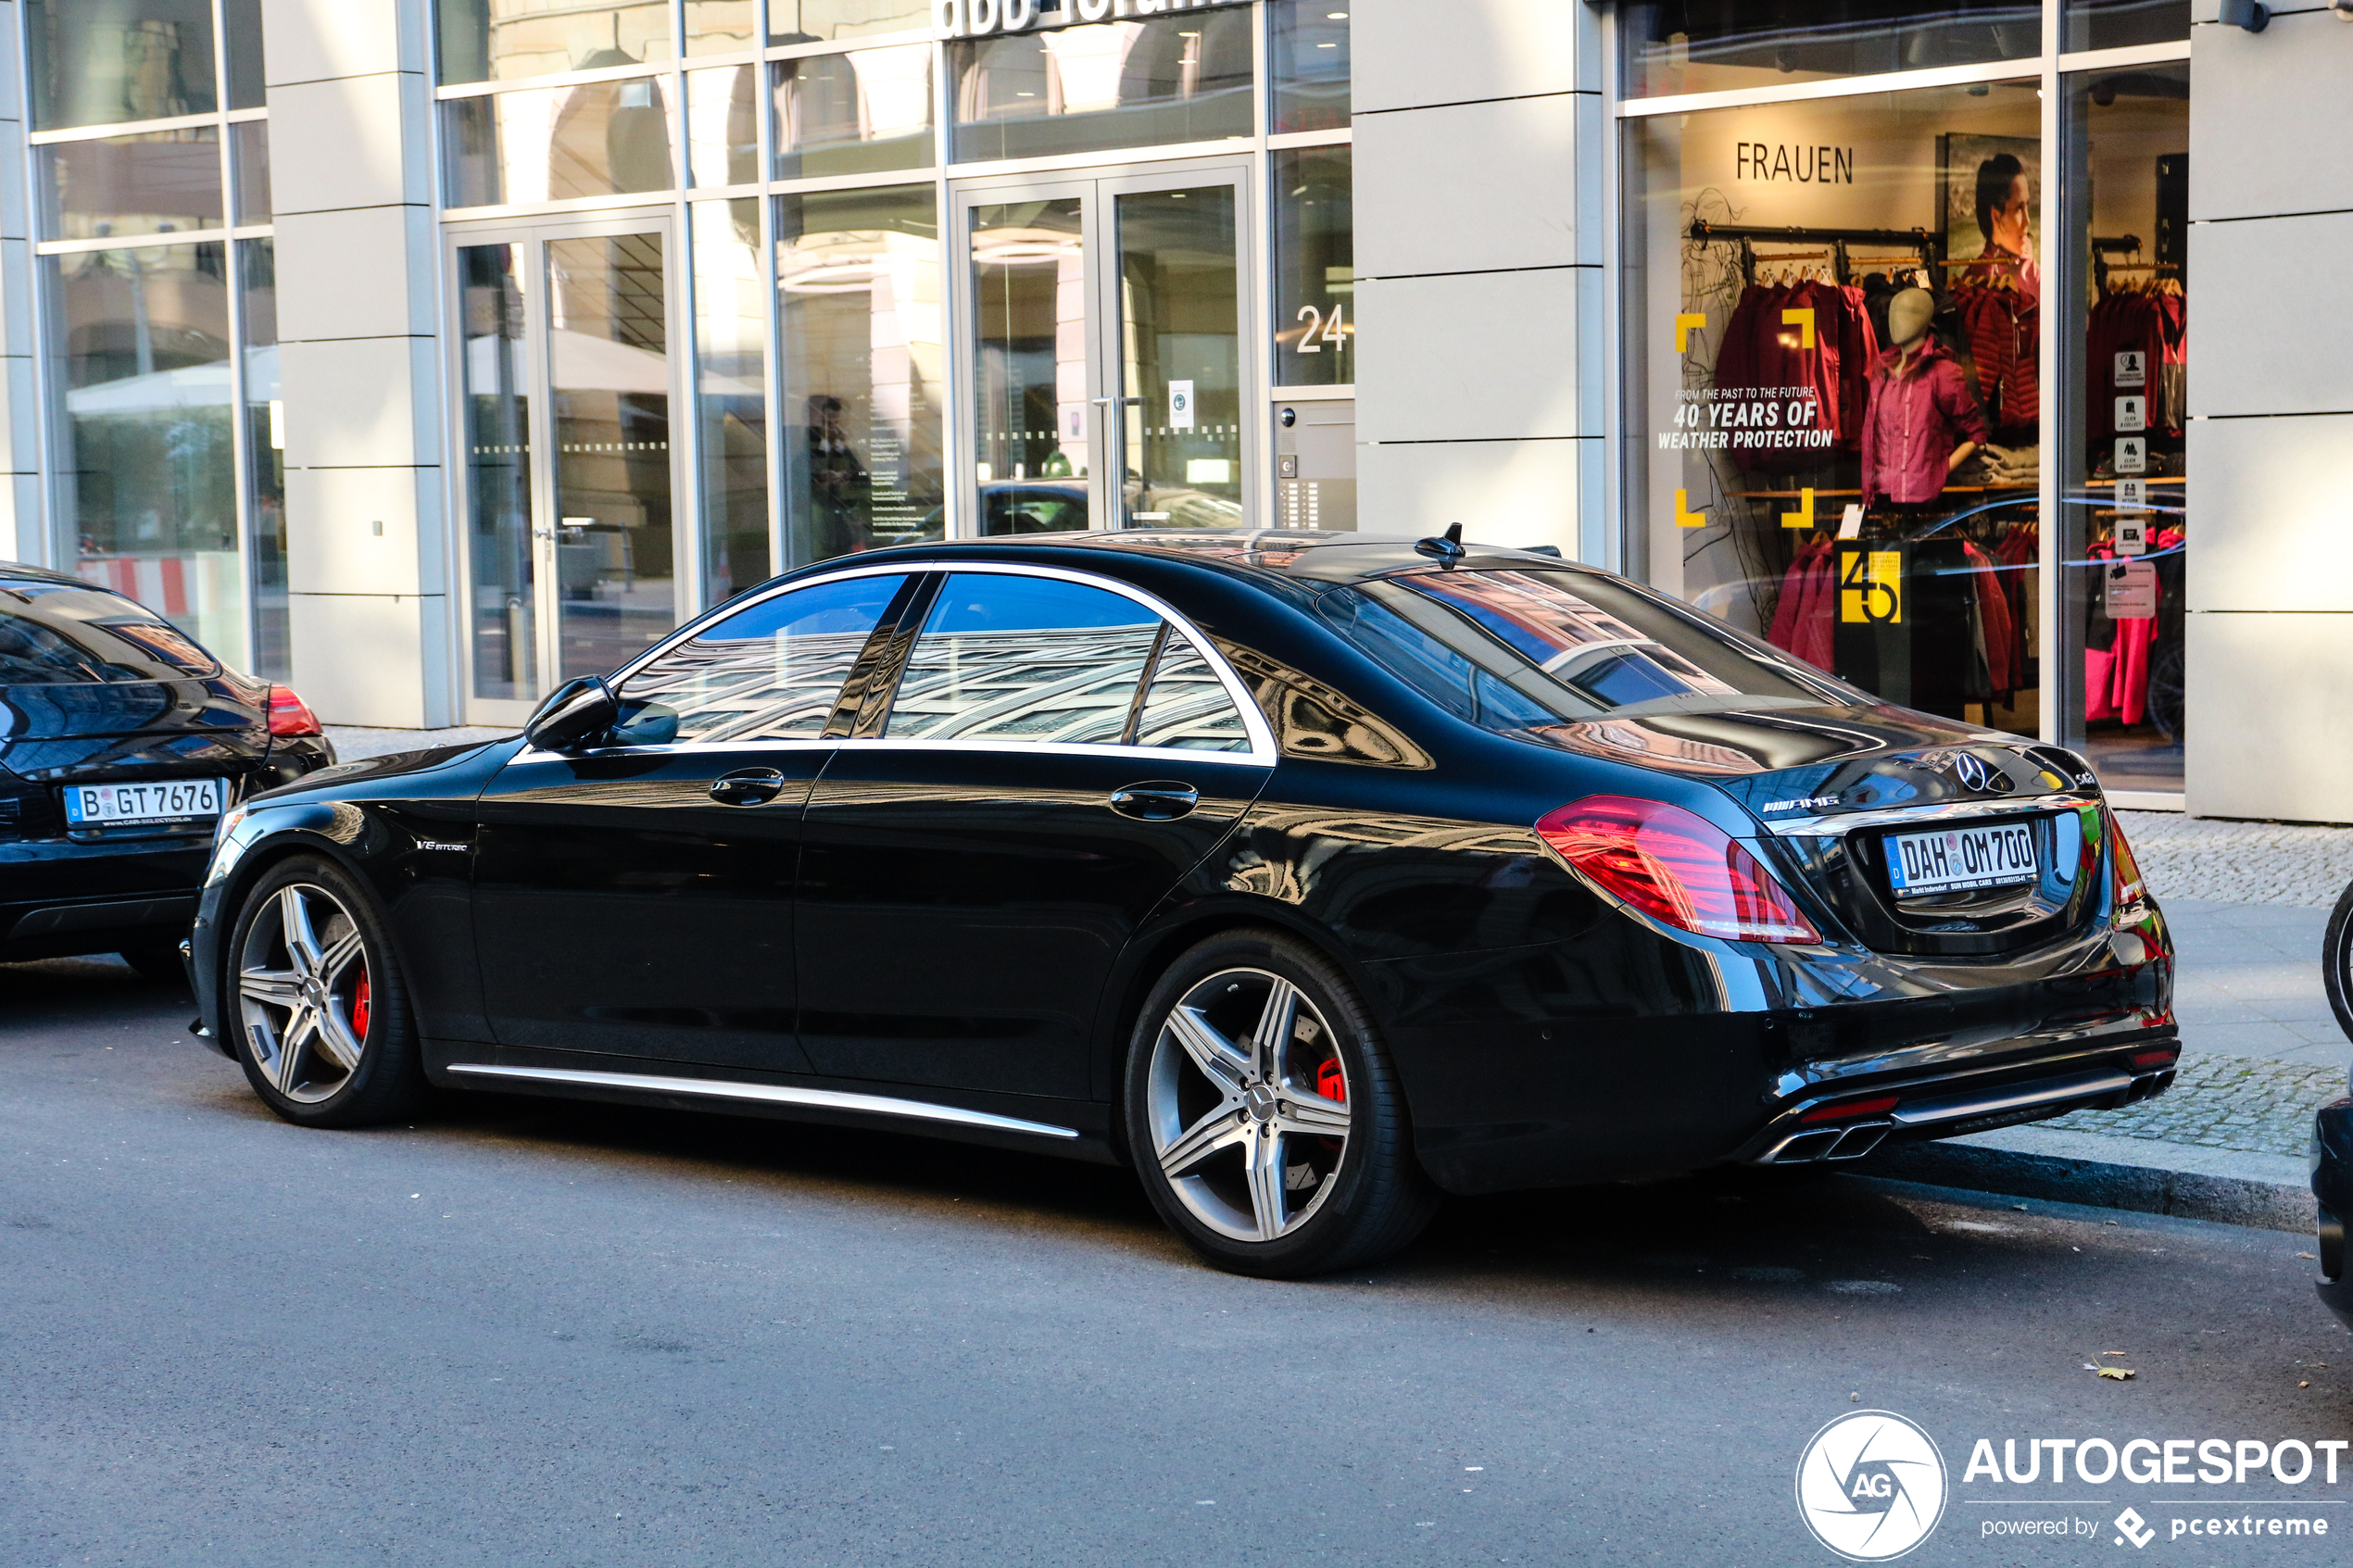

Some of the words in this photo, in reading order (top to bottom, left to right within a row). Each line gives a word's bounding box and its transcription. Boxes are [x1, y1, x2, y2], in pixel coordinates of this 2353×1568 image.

[1737, 142, 1852, 184] FRAUEN
[1297, 304, 1347, 353] 24
[1675, 389, 1700, 400] FROM
[1703, 389, 1719, 399] THE
[1721, 388, 1744, 399] PAST
[1745, 387, 1757, 398] TO
[1759, 387, 1778, 398] THE
[1779, 386, 1815, 398] FUTURE
[1673, 404, 1700, 428] 40
[1708, 401, 1780, 428] YEARS
[1787, 401, 1818, 426] OF
[1658, 431, 1730, 449] WEATHER
[1732, 429, 1833, 448] PROTECTION
[82, 790, 99, 817] B
[117, 787, 147, 814] GT
[154, 785, 213, 812] 7676
[1793, 796, 1840, 809] AMG
[1893, 868, 1900, 879] D
[1902, 837, 1949, 881] DAH
[1961, 833, 1993, 874] OM
[1991, 829, 2032, 871] 700
[1962, 880, 1978, 888] MOBIL
[1978, 878, 1992, 886] CARS
